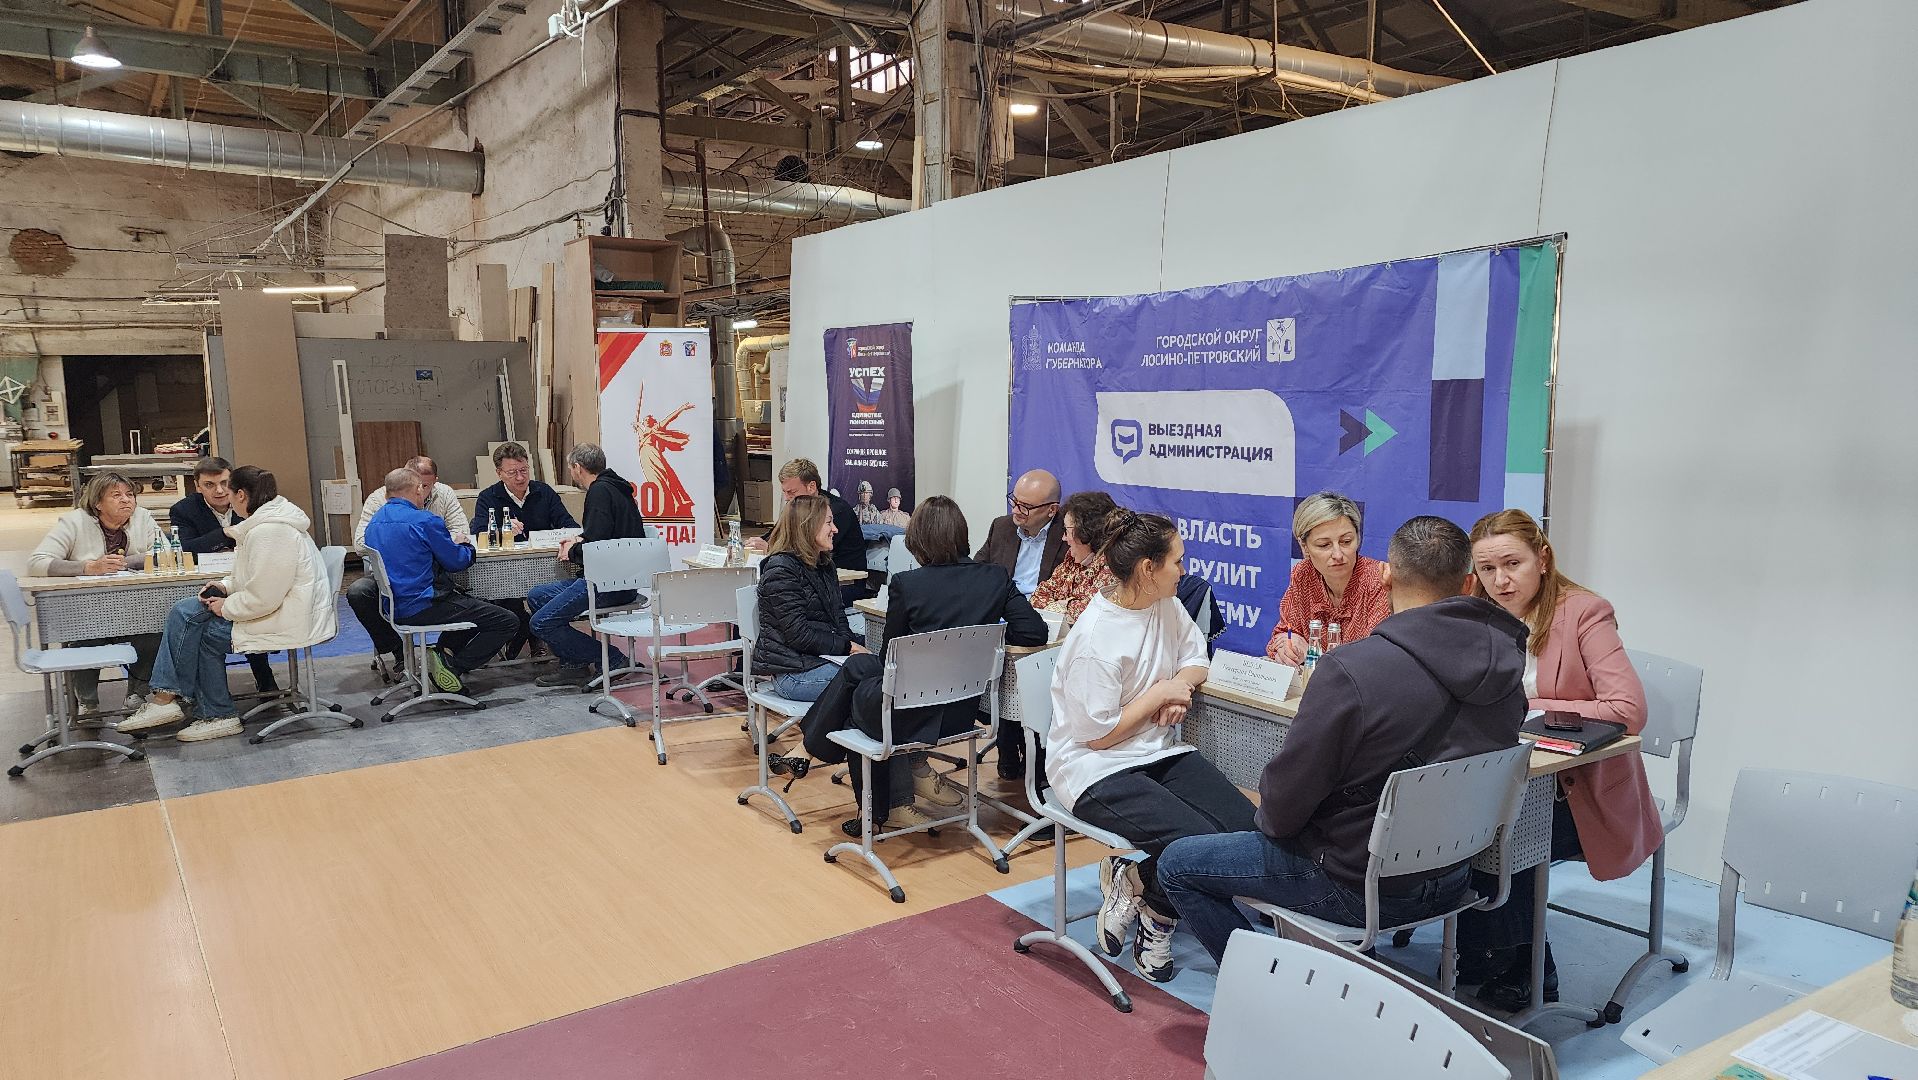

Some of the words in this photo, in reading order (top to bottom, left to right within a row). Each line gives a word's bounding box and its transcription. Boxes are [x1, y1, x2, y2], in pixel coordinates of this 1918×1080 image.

[1156, 329, 1222, 349] ГОРОДСКОЙ
[1224, 328, 1263, 345] ОКРУГ
[1047, 341, 1086, 356] КОМАНДА
[1141, 345, 1261, 367] ЛОСИНО-ПЕТРОВСКИЙ
[849, 366, 886, 378] УСПЕХ
[1045, 357, 1103, 370] ГУБЕРНАТОРА
[1148, 423, 1223, 438] ВЫЕЗДНАЯ
[1149, 443, 1274, 462] АДМИНИСТРАЦИЯ
[1177, 517, 1262, 549] ВЛАСТЬ
[1181, 557, 1262, 589] РУЛИТ
